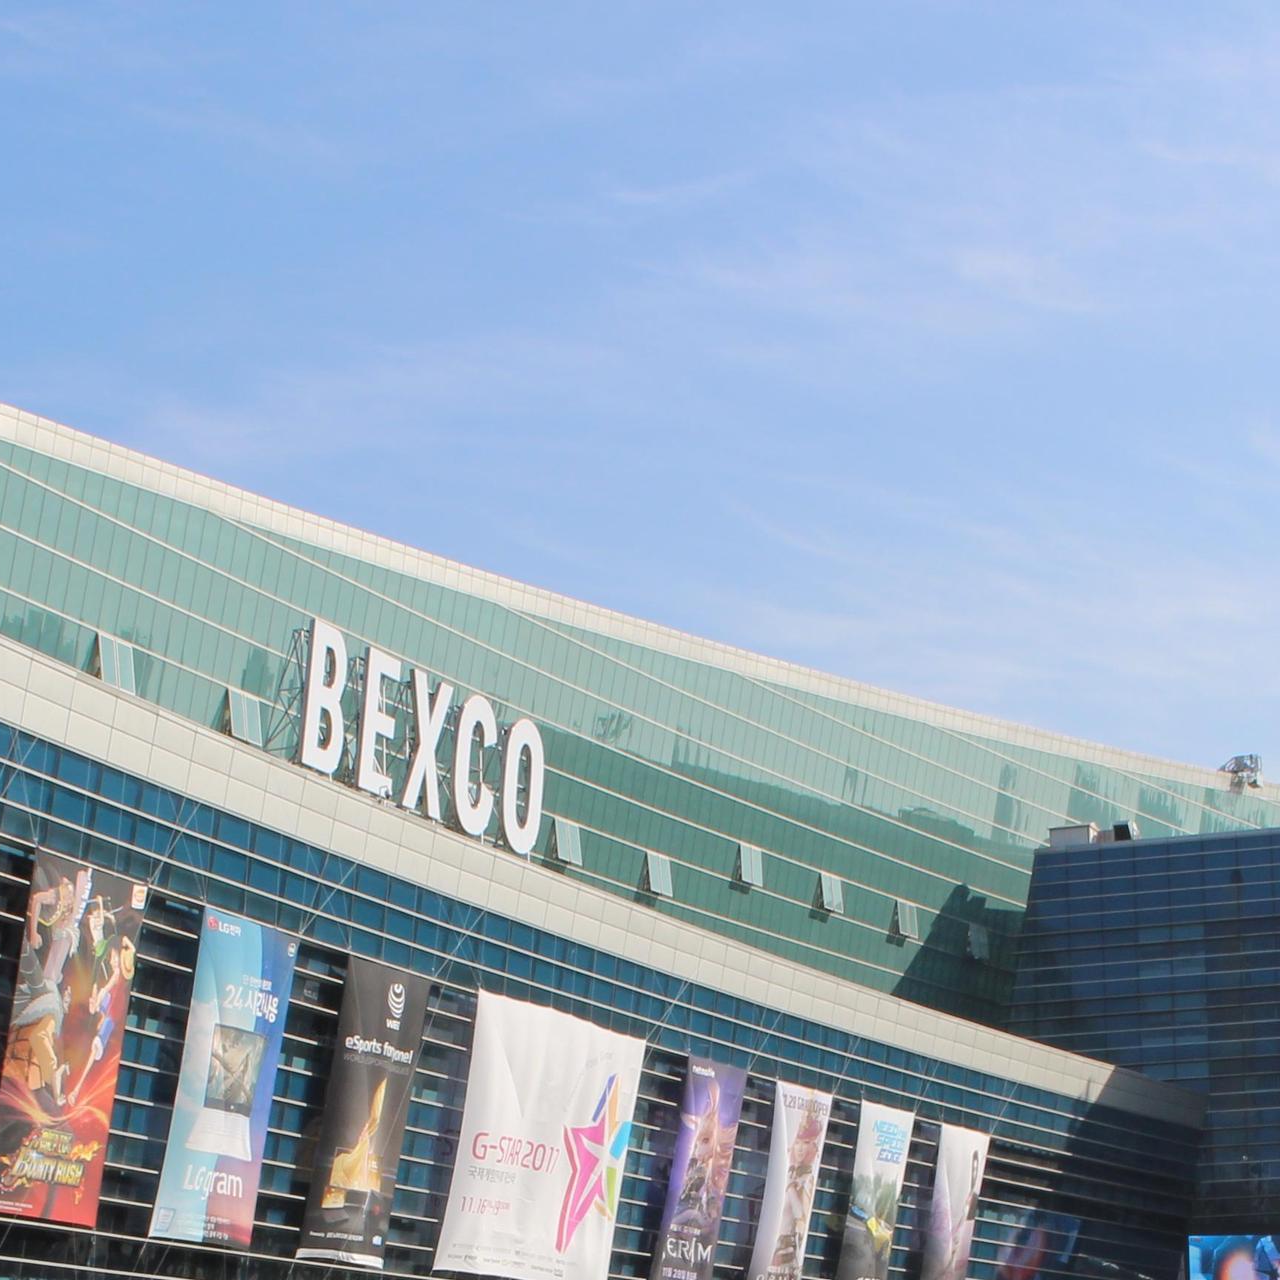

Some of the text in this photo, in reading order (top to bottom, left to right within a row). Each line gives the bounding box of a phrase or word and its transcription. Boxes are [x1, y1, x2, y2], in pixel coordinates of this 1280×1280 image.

[300, 617, 545, 855] BEXCO
[345, 1034, 382, 1054] eSports
[472, 1132, 560, 1174] G-STAR 2017
[201, 1170, 243, 1200] gram
